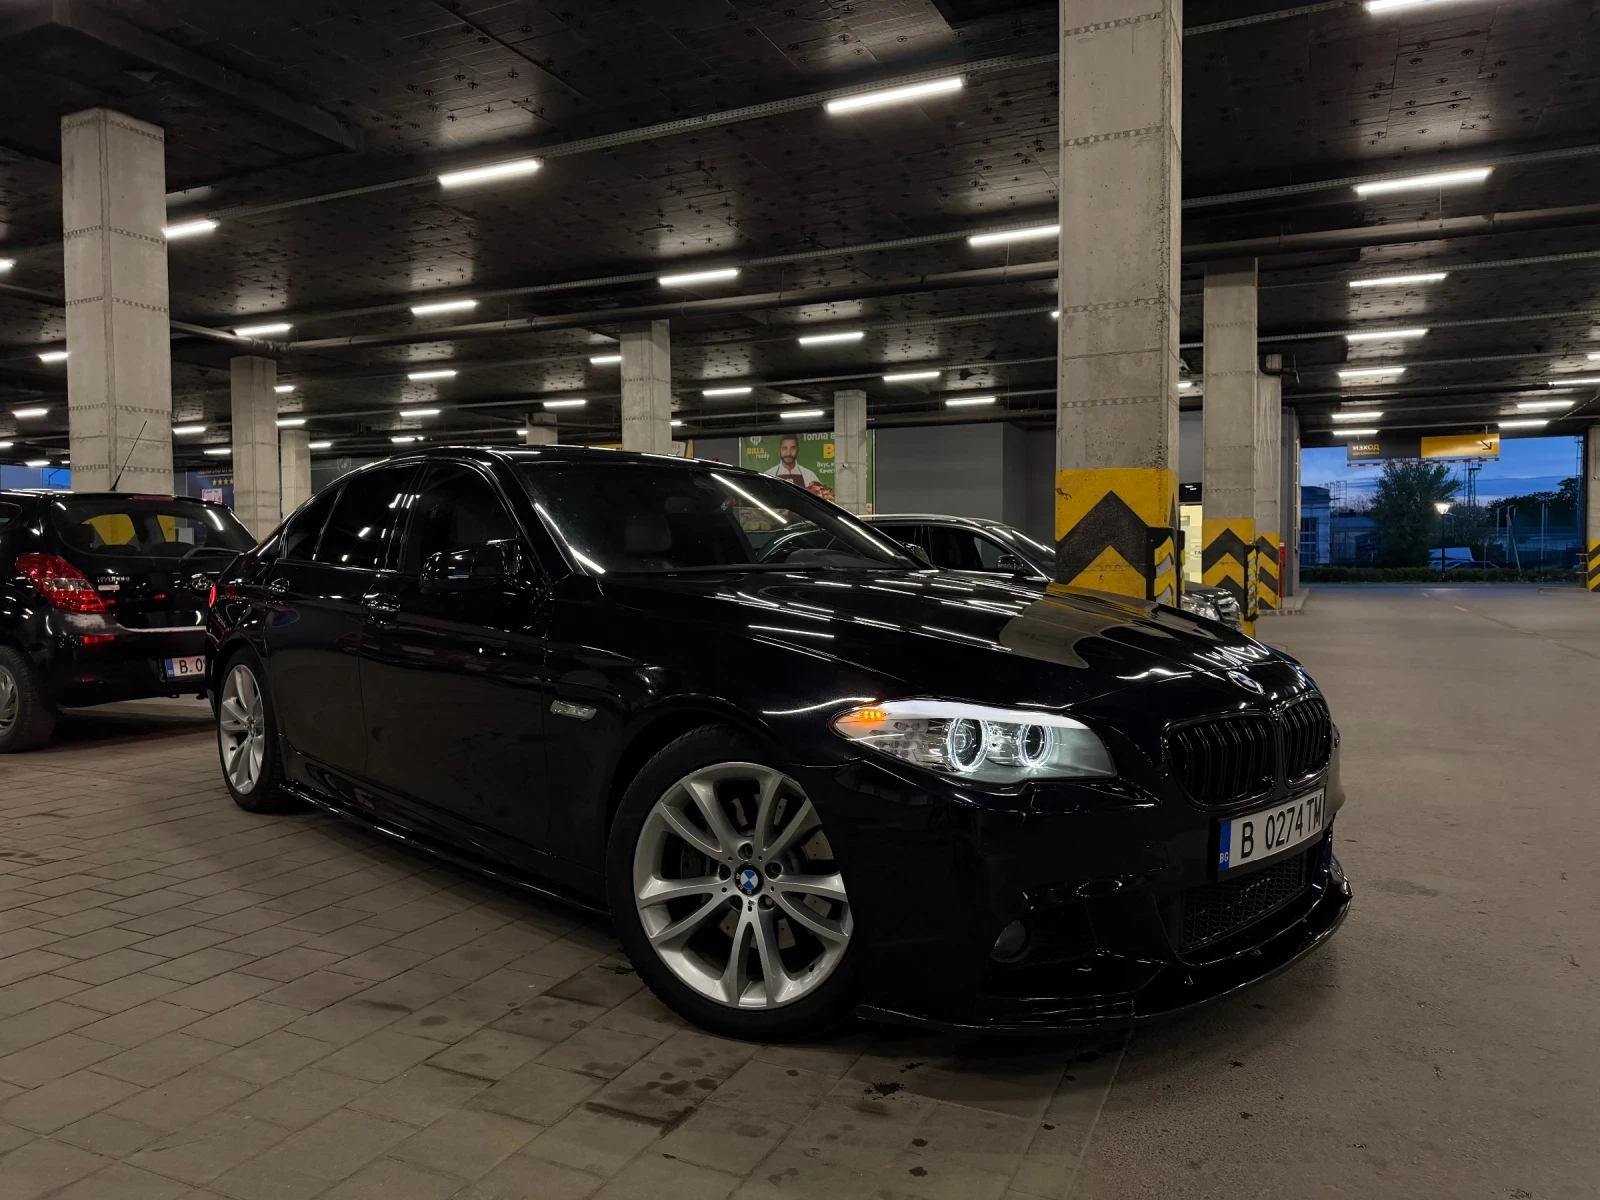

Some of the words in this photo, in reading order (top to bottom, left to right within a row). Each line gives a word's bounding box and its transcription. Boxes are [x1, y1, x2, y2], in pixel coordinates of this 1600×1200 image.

[746, 447, 765, 455] BILLA
[1352, 443, 1380, 451] ИЗХОД
[1241, 821, 1254, 859] B
[1265, 803, 1303, 850] 0274
[1306, 794, 1323, 833] TM
[1219, 851, 1229, 864] BG
